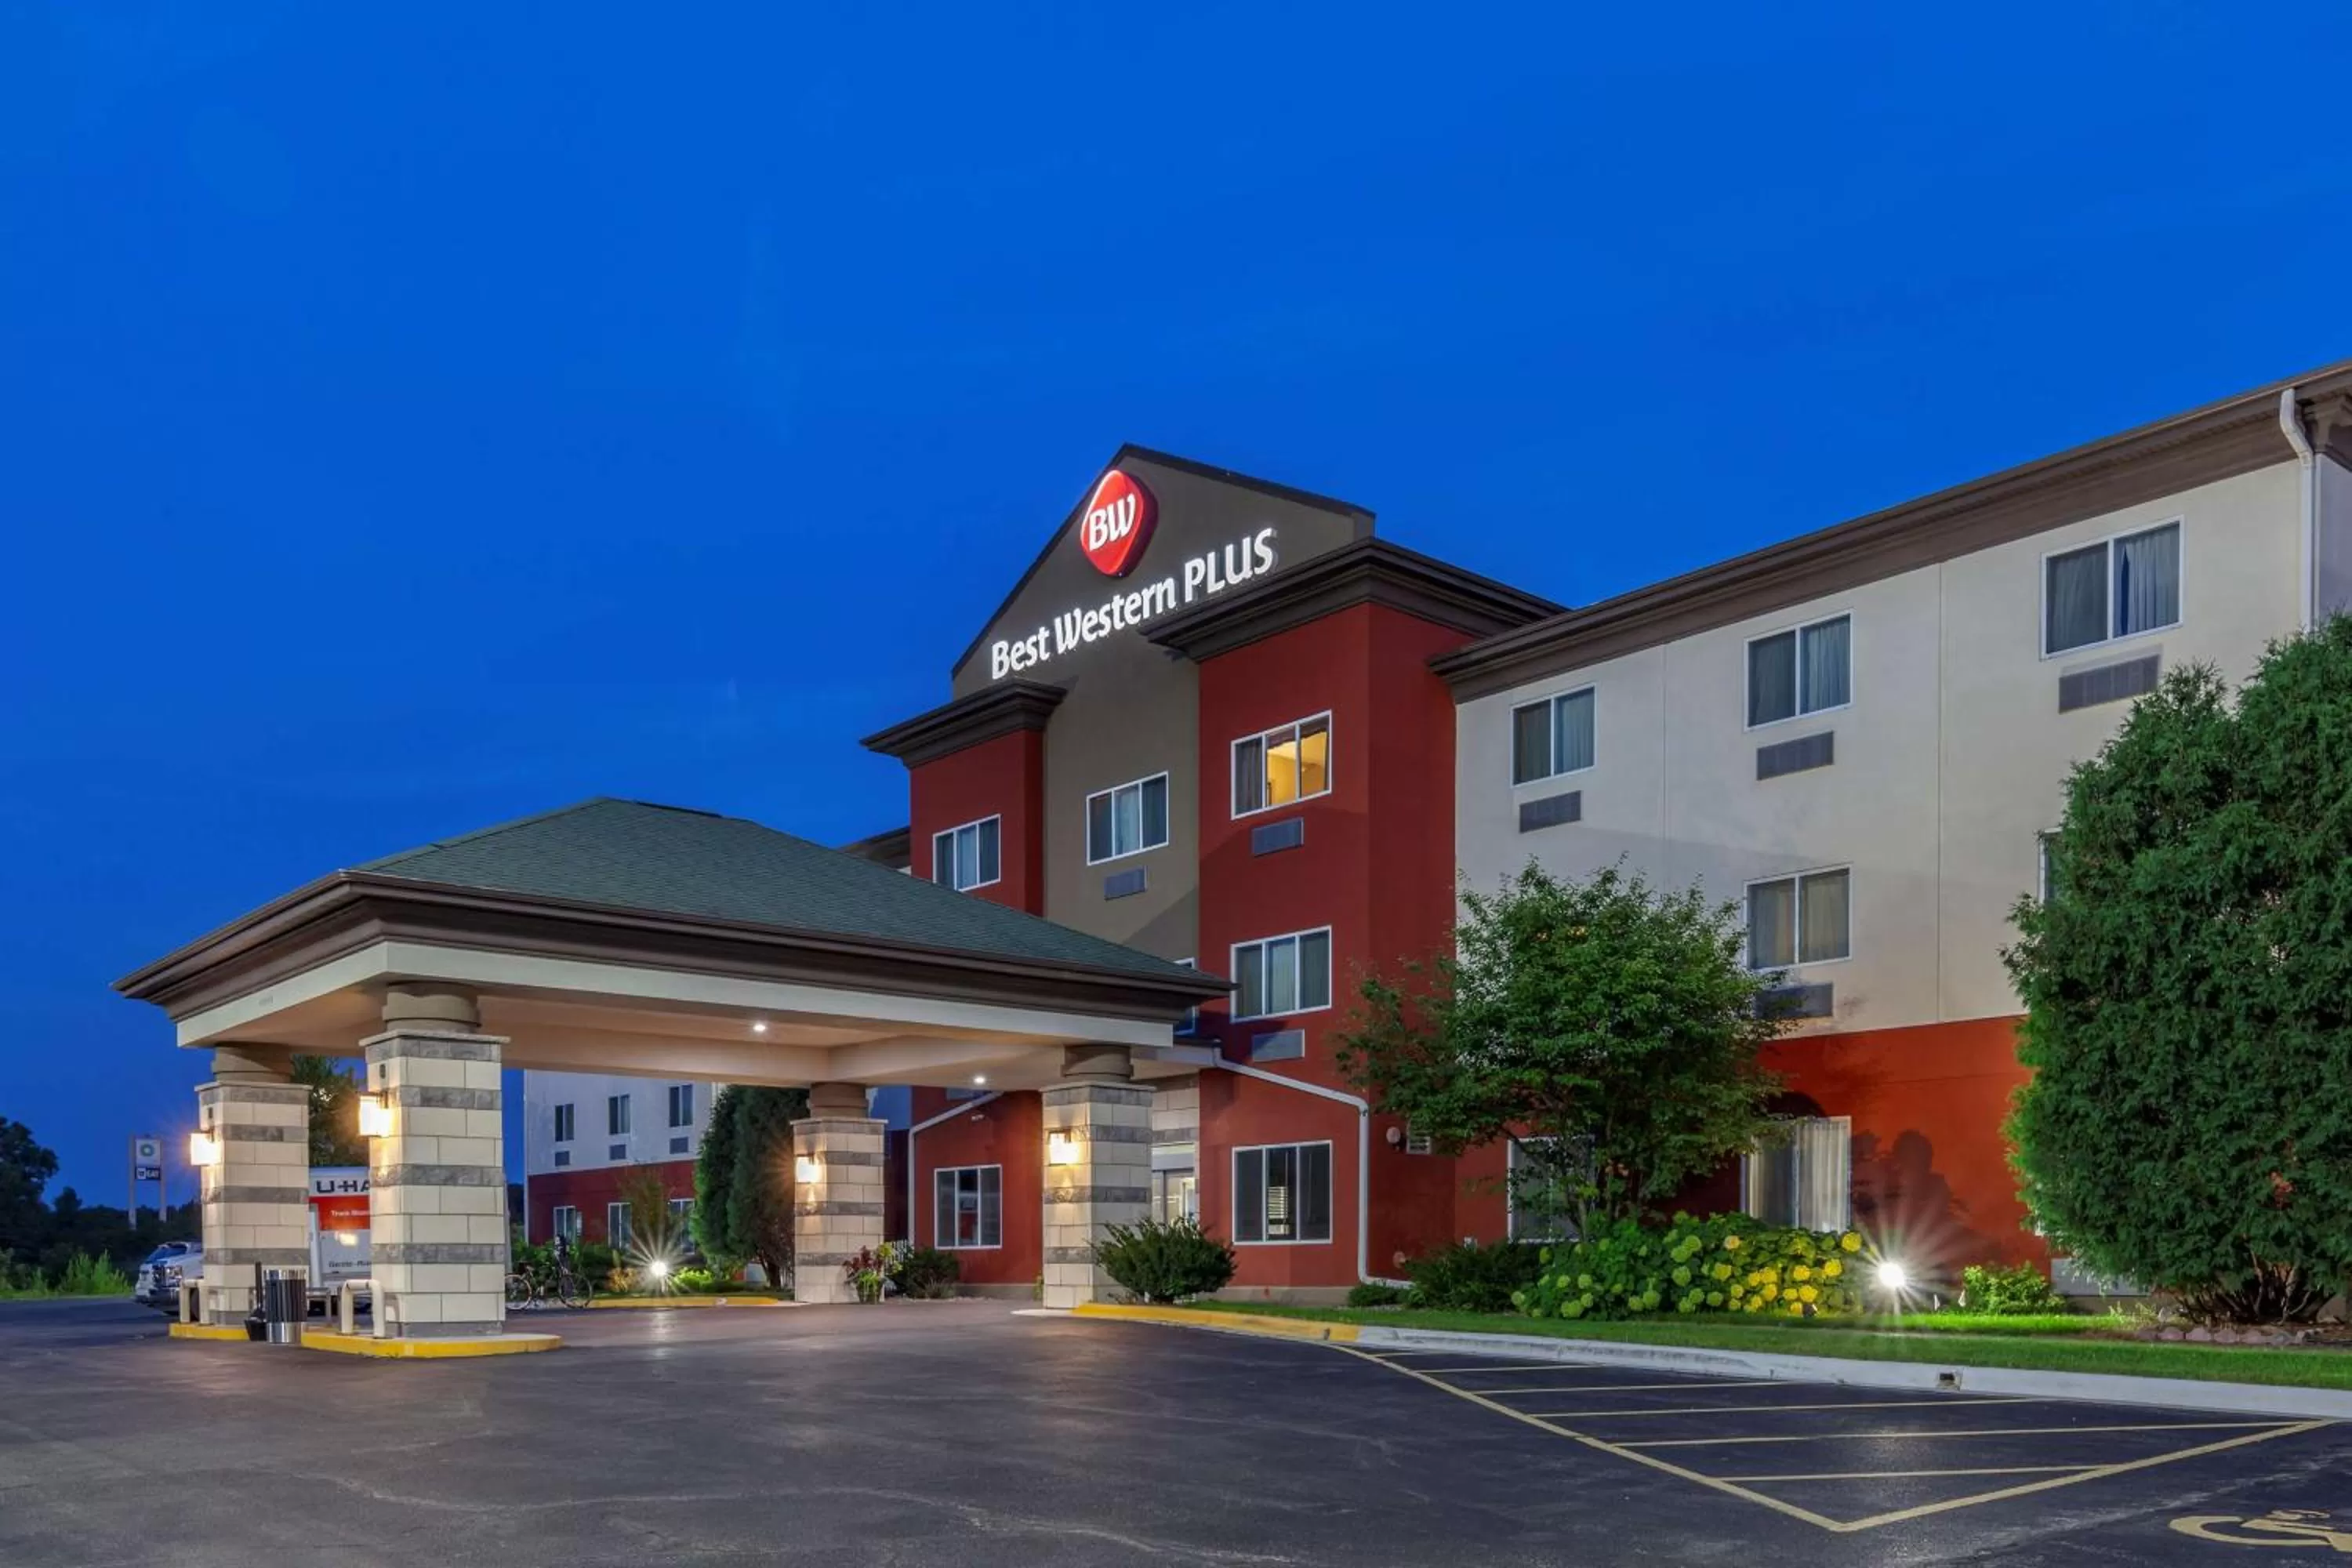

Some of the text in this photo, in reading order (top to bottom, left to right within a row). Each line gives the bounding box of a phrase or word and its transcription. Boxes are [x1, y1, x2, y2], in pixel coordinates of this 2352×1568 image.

[1089, 492, 1136, 552] BW
[992, 527, 1276, 680] Best Western PLUS
